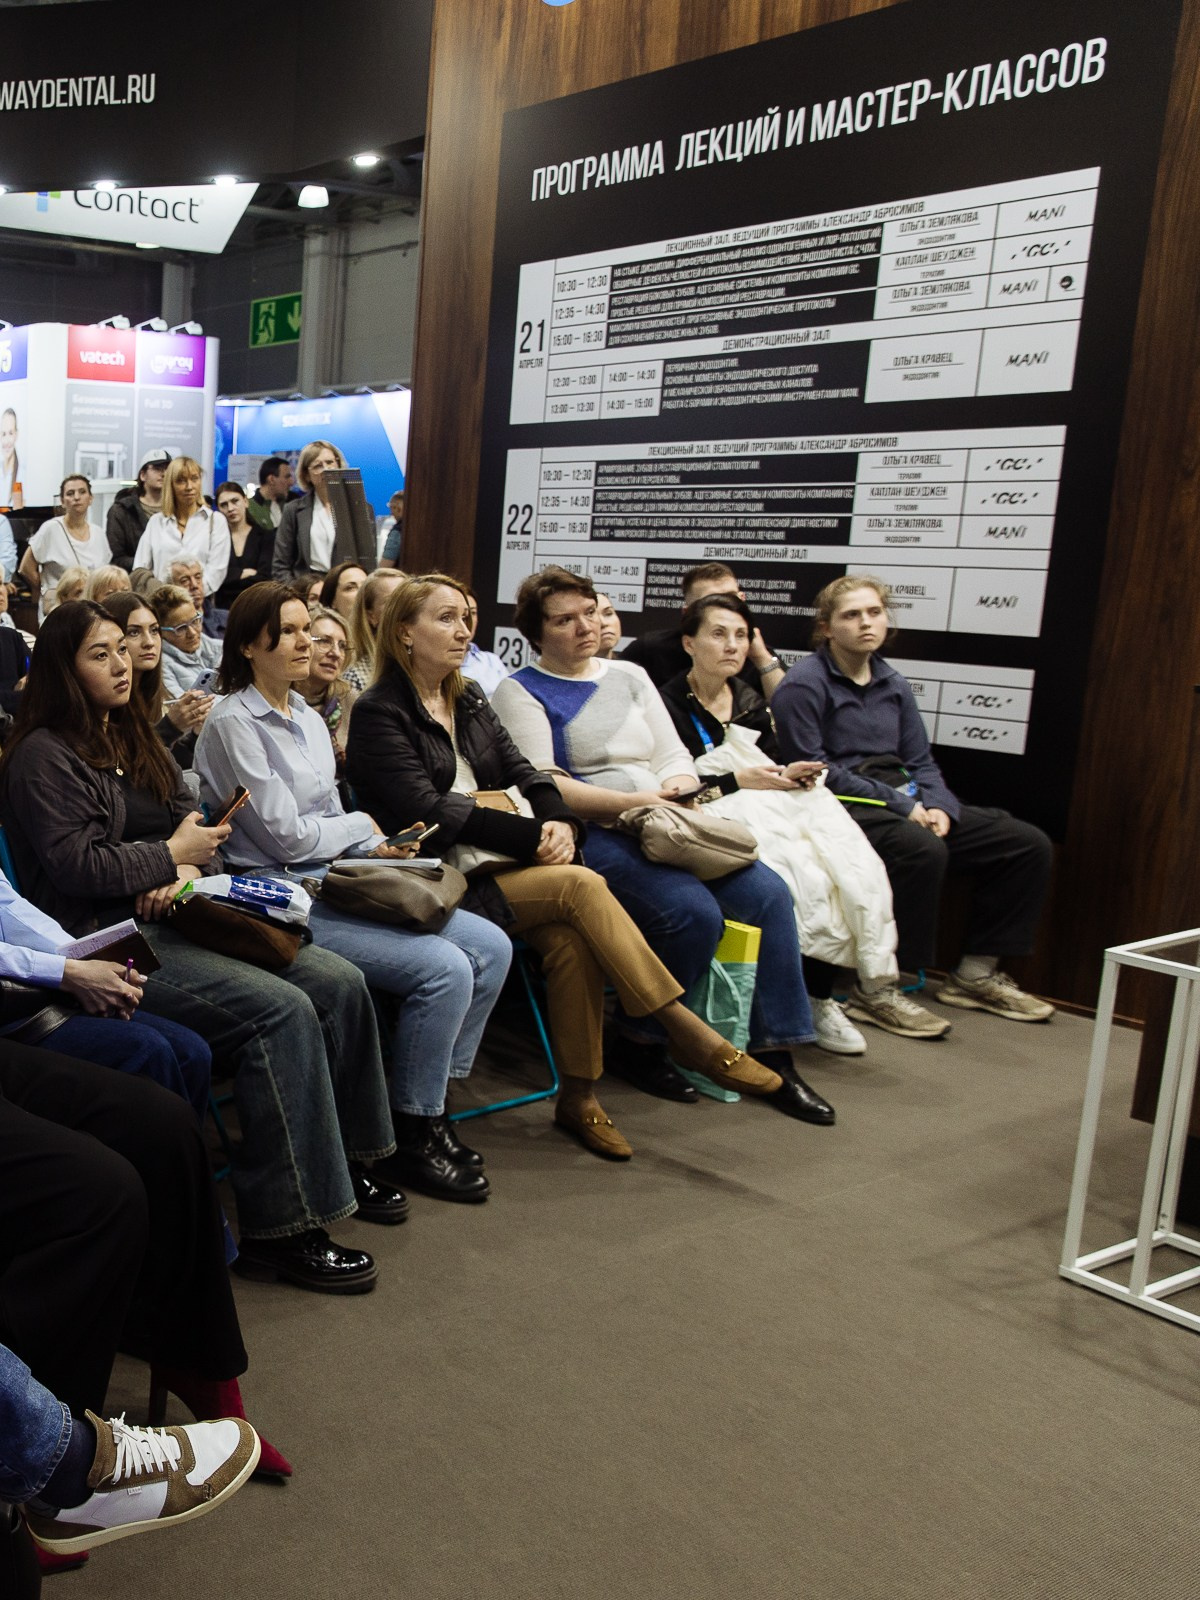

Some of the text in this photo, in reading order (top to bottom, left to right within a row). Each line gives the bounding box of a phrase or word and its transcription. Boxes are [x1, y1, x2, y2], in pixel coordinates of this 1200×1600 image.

[531, 37, 1107, 201] ПРОГРАММА ЛЕКЦИЙ И МАСТЕР-КЛАССОВ
[1025, 204, 1066, 223] MANI
[519, 319, 546, 354] 21
[79, 350, 126, 366] vatech
[518, 357, 544, 369] АПРЕЛЯ
[506, 504, 533, 535] 22
[499, 636, 523, 668] 23
